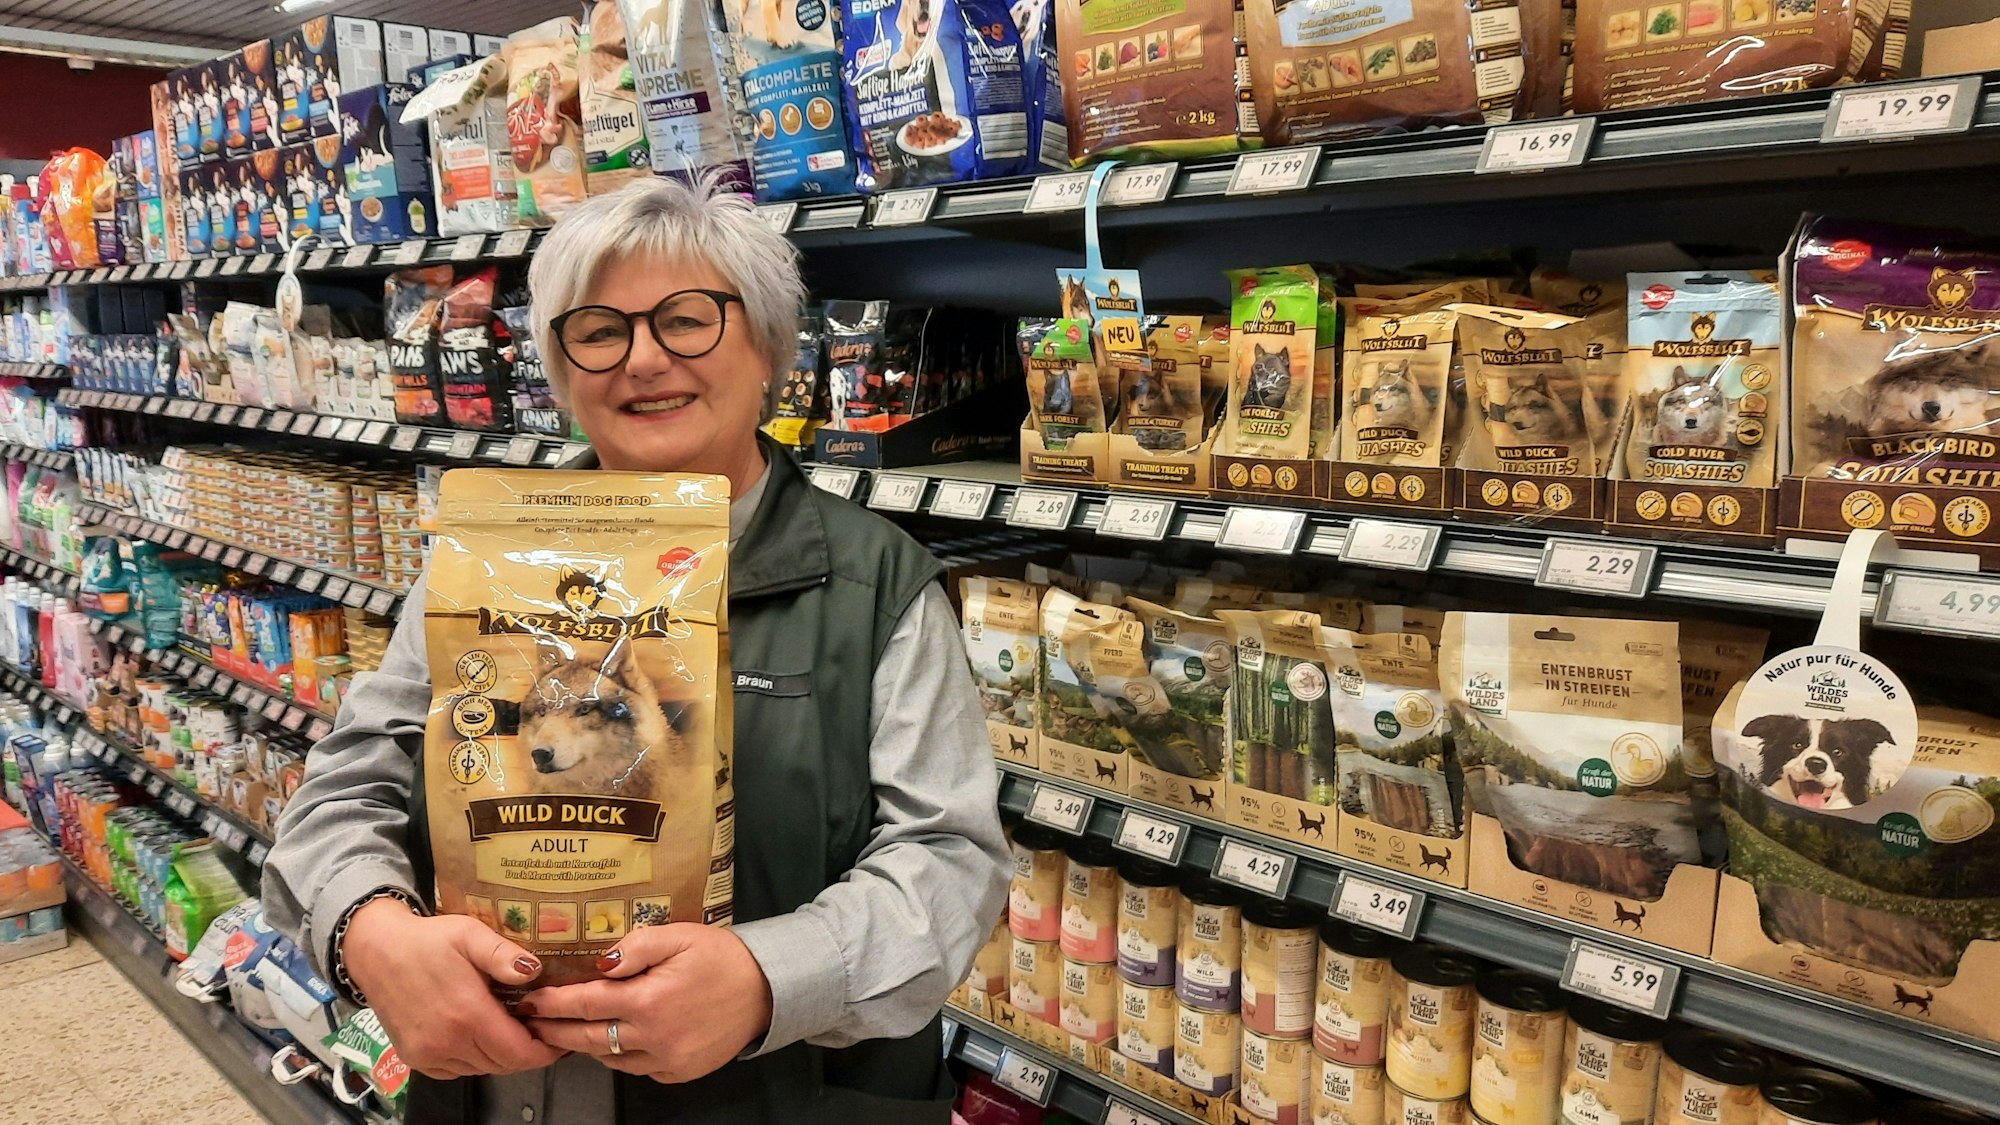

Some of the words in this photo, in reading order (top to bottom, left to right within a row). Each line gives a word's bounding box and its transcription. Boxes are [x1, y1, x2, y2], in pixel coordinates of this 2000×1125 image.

[852, 0, 896, 14] EDEKA
[1878, 94, 1951, 117] 19,99
[1189, 112, 1197, 124] 2
[1199, 110, 1216, 125] kg
[1520, 133, 1572, 151] 16,99
[1260, 159, 1302, 176] 17,99
[1055, 181, 1084, 196] 3,95
[1125, 174, 1162, 189] 17,99
[901, 198, 924, 210] 2,79
[1108, 326, 1134, 344] NEU
[1658, 340, 1744, 356] WOLFSBLUT
[440, 351, 483, 374] AWS
[1381, 430, 1408, 438] DUCK
[1528, 448, 1557, 458] DUCK
[1656, 448, 1685, 459] COLD
[1689, 448, 1726, 461] RIVER
[1032, 456, 1061, 466] TRAINING
[1062, 458, 1088, 467] TREATS
[1126, 463, 1160, 473] TRAINING
[1161, 465, 1189, 474] TREATS
[1645, 462, 1746, 482] SQUASHIES
[894, 485, 916, 497] 1,99
[958, 491, 983, 505] 1,99
[522, 495, 581, 506] PREMIUM
[584, 496, 612, 506] DOG
[614, 496, 650, 506] FOOD
[1035, 500, 1063, 514] 2,69
[1129, 509, 1160, 524] 2,69
[1383, 533, 1422, 550] 2,29
[1586, 556, 1633, 574] 2,29
[1940, 591, 2000, 614] 4,99
[999, 612, 1014, 620] ENTE
[1541, 663, 1632, 682] ENTENBRUST
[1764, 657, 1802, 682] Natur
[1806, 654, 1832, 667] pur
[1835, 654, 1858, 668] für
[1858, 663, 1896, 701] Hunde
[736, 674, 774, 690] Braun
[1546, 680, 1560, 691] IN
[1564, 681, 1631, 698] STREIFEN
[1465, 689, 1505, 700] WILDES
[1806, 684, 1848, 698] WILDES
[1469, 698, 1498, 708] LAND
[1560, 696, 1578, 707] für
[1582, 698, 1618, 710] Hunde
[1810, 693, 1842, 705] LAND
[1581, 775, 1613, 790] NATUR
[1054, 798, 1081, 817] 3,49
[1240, 795, 1261, 811] 95%
[497, 805, 552, 825] WILD
[561, 805, 627, 826] DUCK
[1145, 826, 1175, 845] 4,29
[1354, 827, 1377, 843] 95%
[1882, 830, 1919, 847] NATUR
[531, 838, 589, 853] ADULT
[501, 858, 554, 869] Entenfleisch
[555, 859, 571, 868] mit
[572, 859, 621, 869] Kartoffeln
[1247, 857, 1281, 878] 4,29
[505, 870, 528, 880] Duck
[528, 871, 551, 881] Meat
[574, 870, 616, 880] Potatoes
[1370, 893, 1407, 916] 3,49
[1611, 965, 1657, 991] 5,99
[1127, 1044, 1142, 1052] WILD
[1019, 1067, 1045, 1087] 2,99
[1181, 1069, 1197, 1078] WILD
[1574, 1106, 1599, 1121] LAMM
